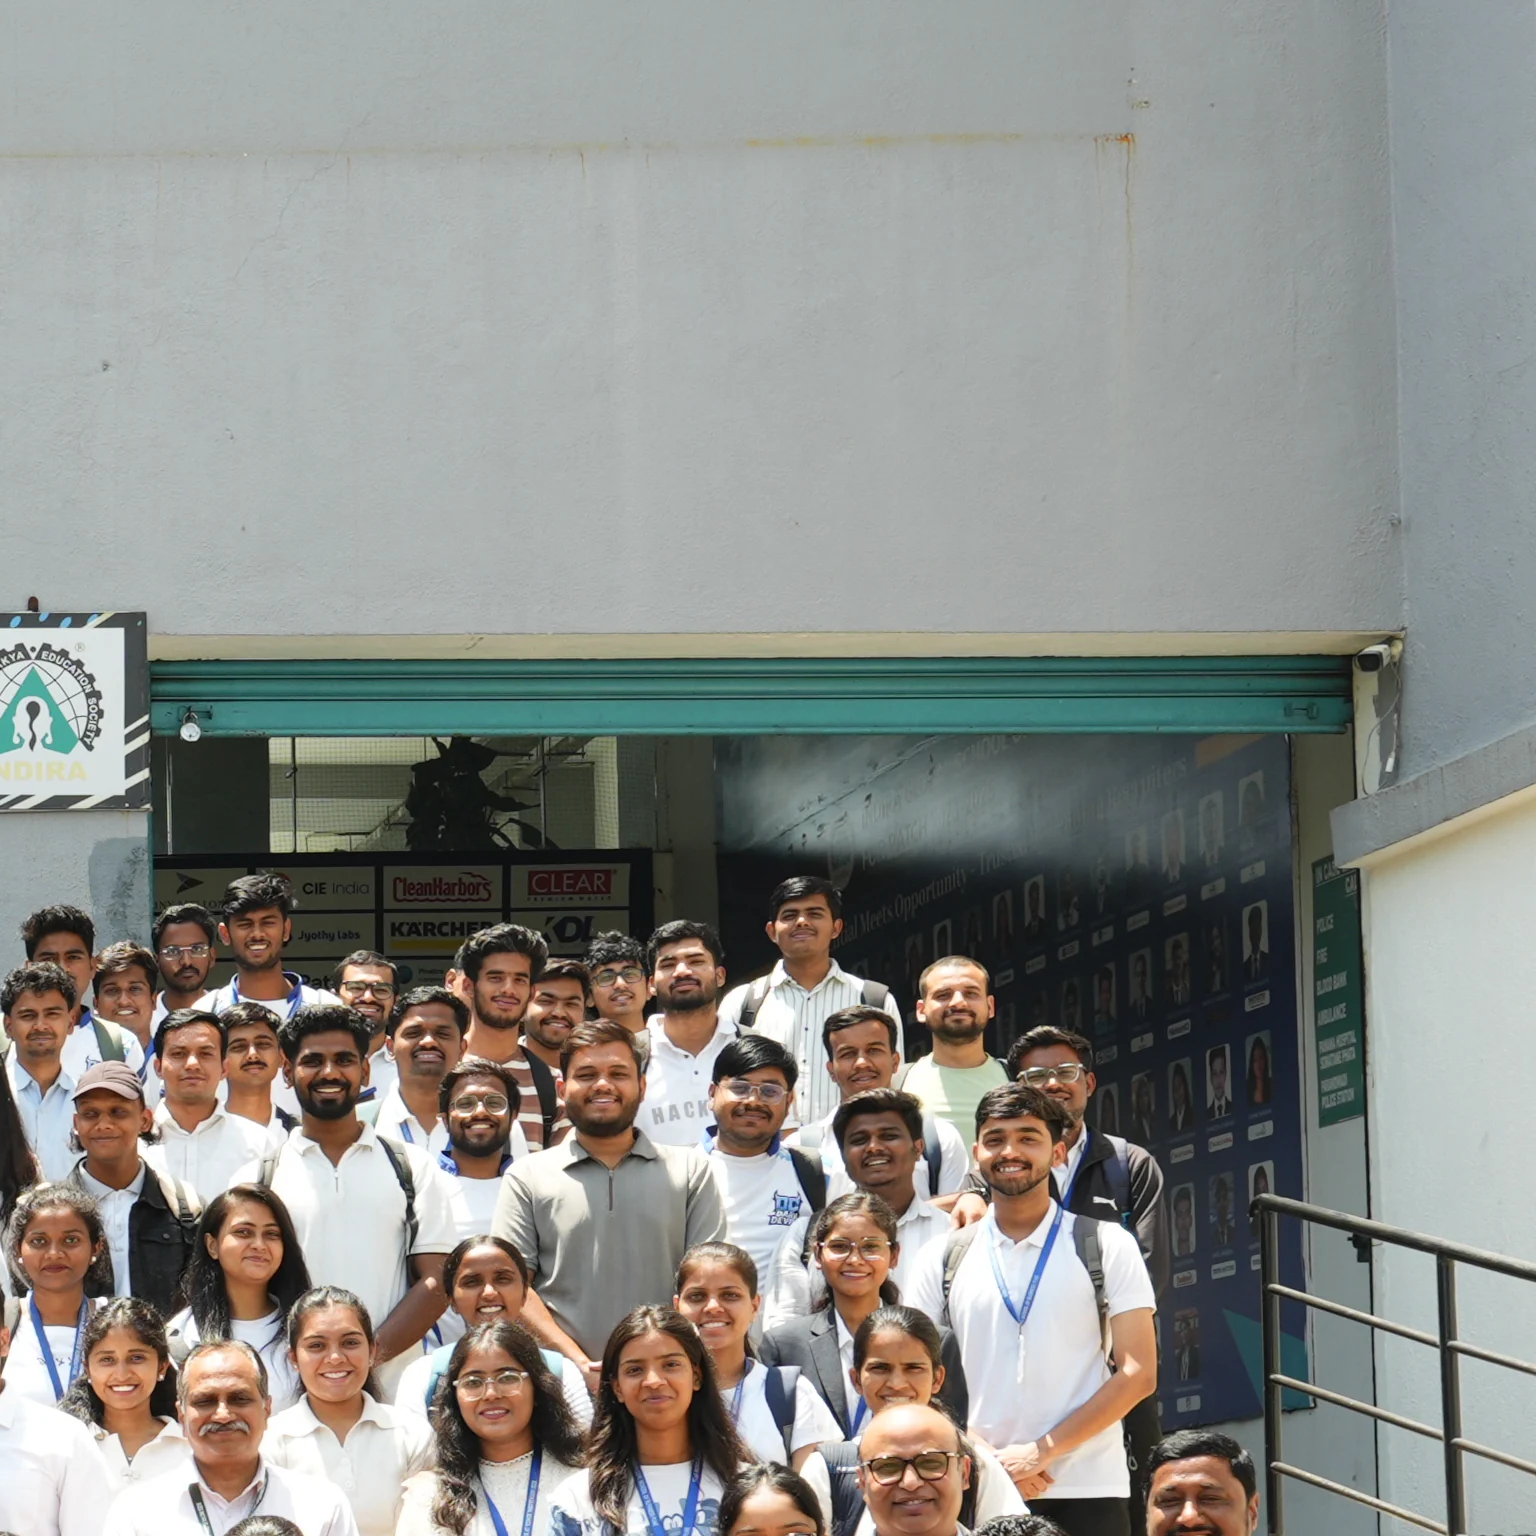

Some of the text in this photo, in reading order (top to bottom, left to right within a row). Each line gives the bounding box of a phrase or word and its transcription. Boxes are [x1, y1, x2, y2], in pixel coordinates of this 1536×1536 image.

[40, 650, 93, 694] EDUCATION
[82, 697, 98, 746] SOCIETY
[303, 881, 370, 895] CIE India
[393, 876, 491, 902] CleanHarbors
[531, 873, 609, 893] CLEAR
[894, 866, 967, 922] Opportunity
[298, 929, 335, 942] Jyothy
